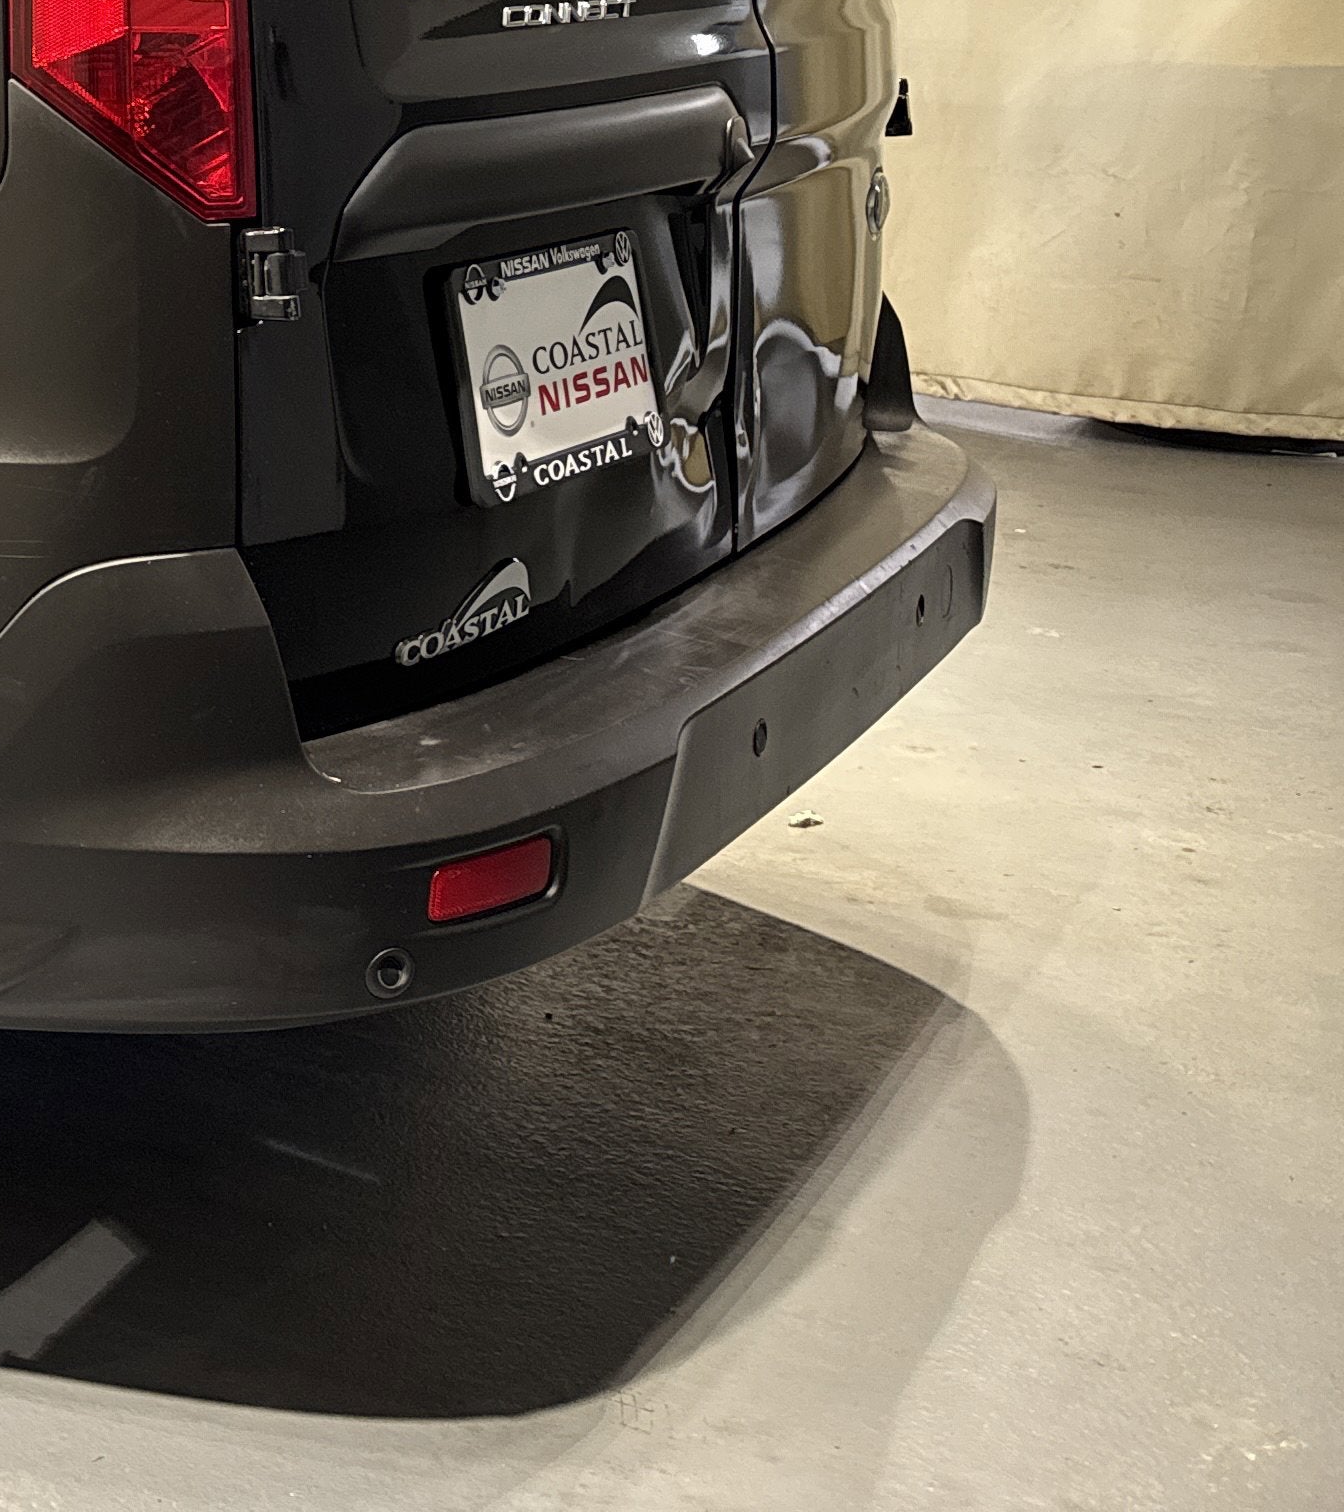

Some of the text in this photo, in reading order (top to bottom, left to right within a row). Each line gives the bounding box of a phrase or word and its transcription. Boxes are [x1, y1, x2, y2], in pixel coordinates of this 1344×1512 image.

[500, 243, 600, 278] NISSAN Volkswagen
[532, 320, 643, 375] COASTAL
[485, 379, 526, 402] NISSAN
[538, 353, 649, 416] NISSAN
[533, 438, 632, 485] COASTAL
[395, 594, 530, 667] COASTAL
